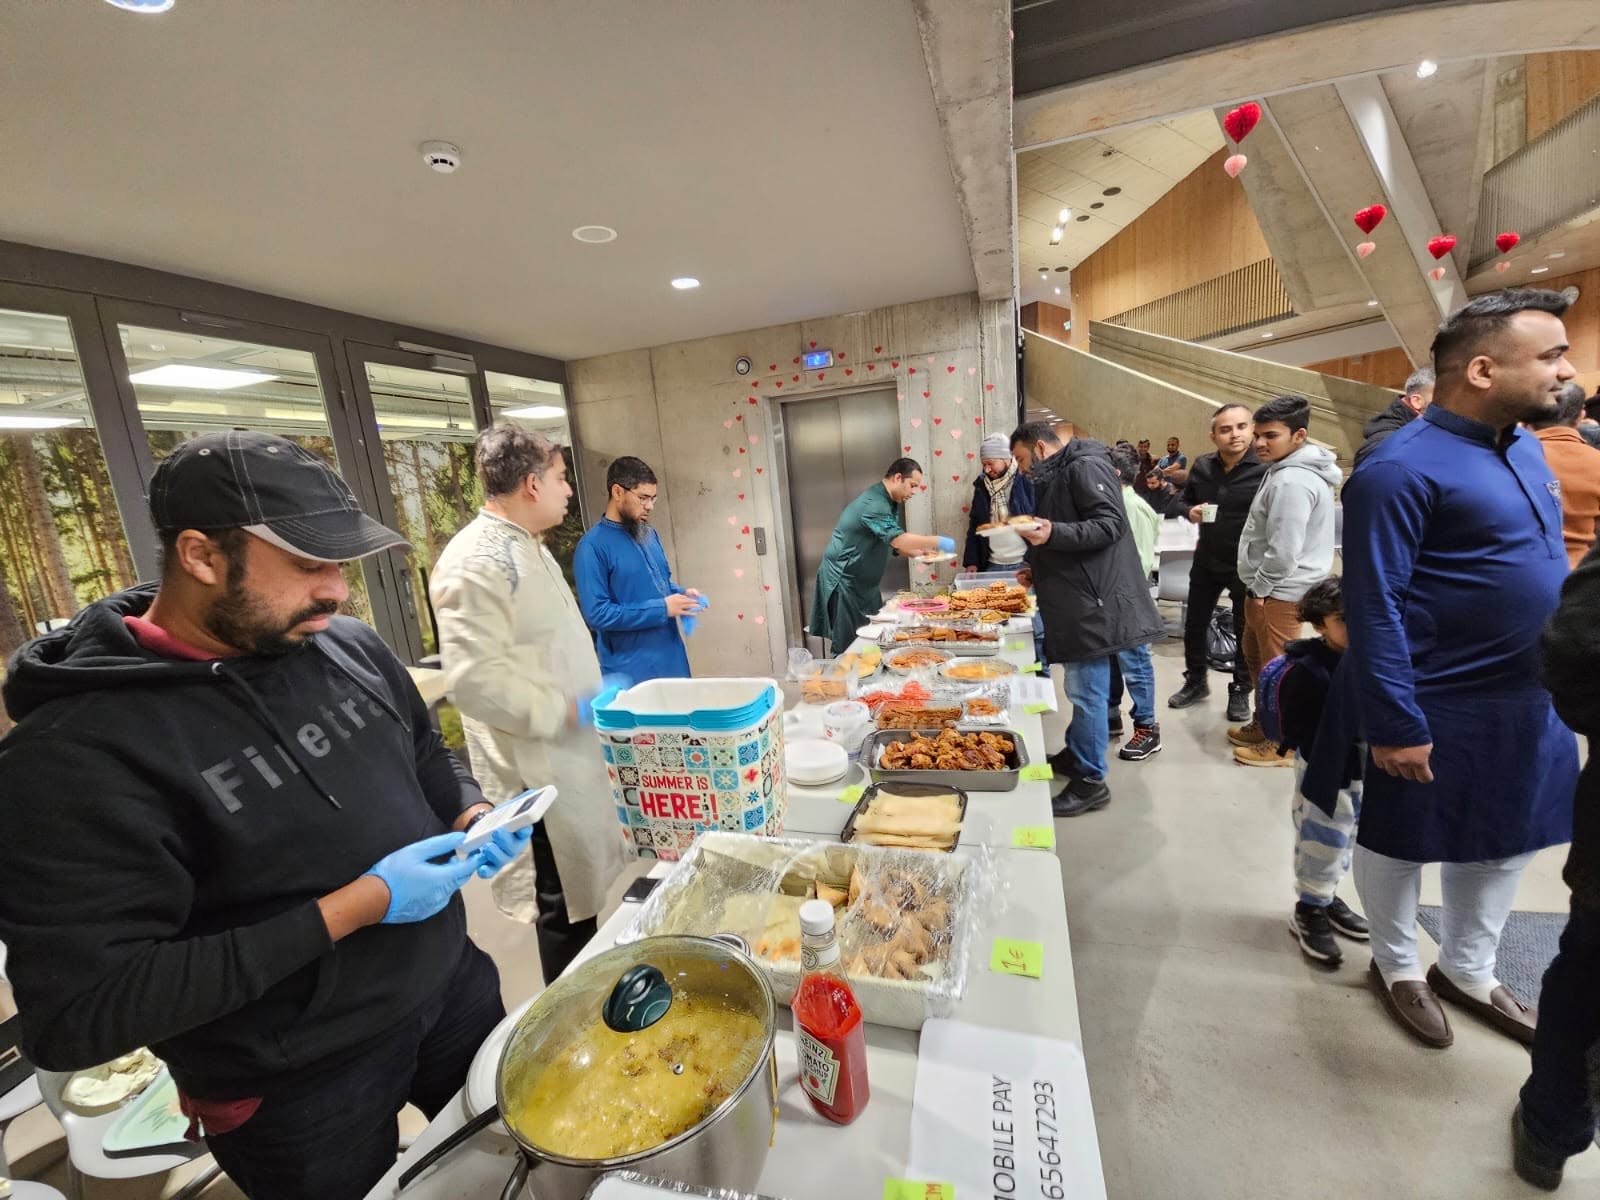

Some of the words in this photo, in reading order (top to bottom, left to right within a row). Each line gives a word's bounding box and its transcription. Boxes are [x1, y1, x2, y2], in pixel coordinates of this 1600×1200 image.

[641, 775, 694, 790] SUMMER
[801, 1047, 830, 1073] OMATO
[992, 1074, 1013, 1113] PAY
[1033, 1080, 1065, 1200] 65647293
